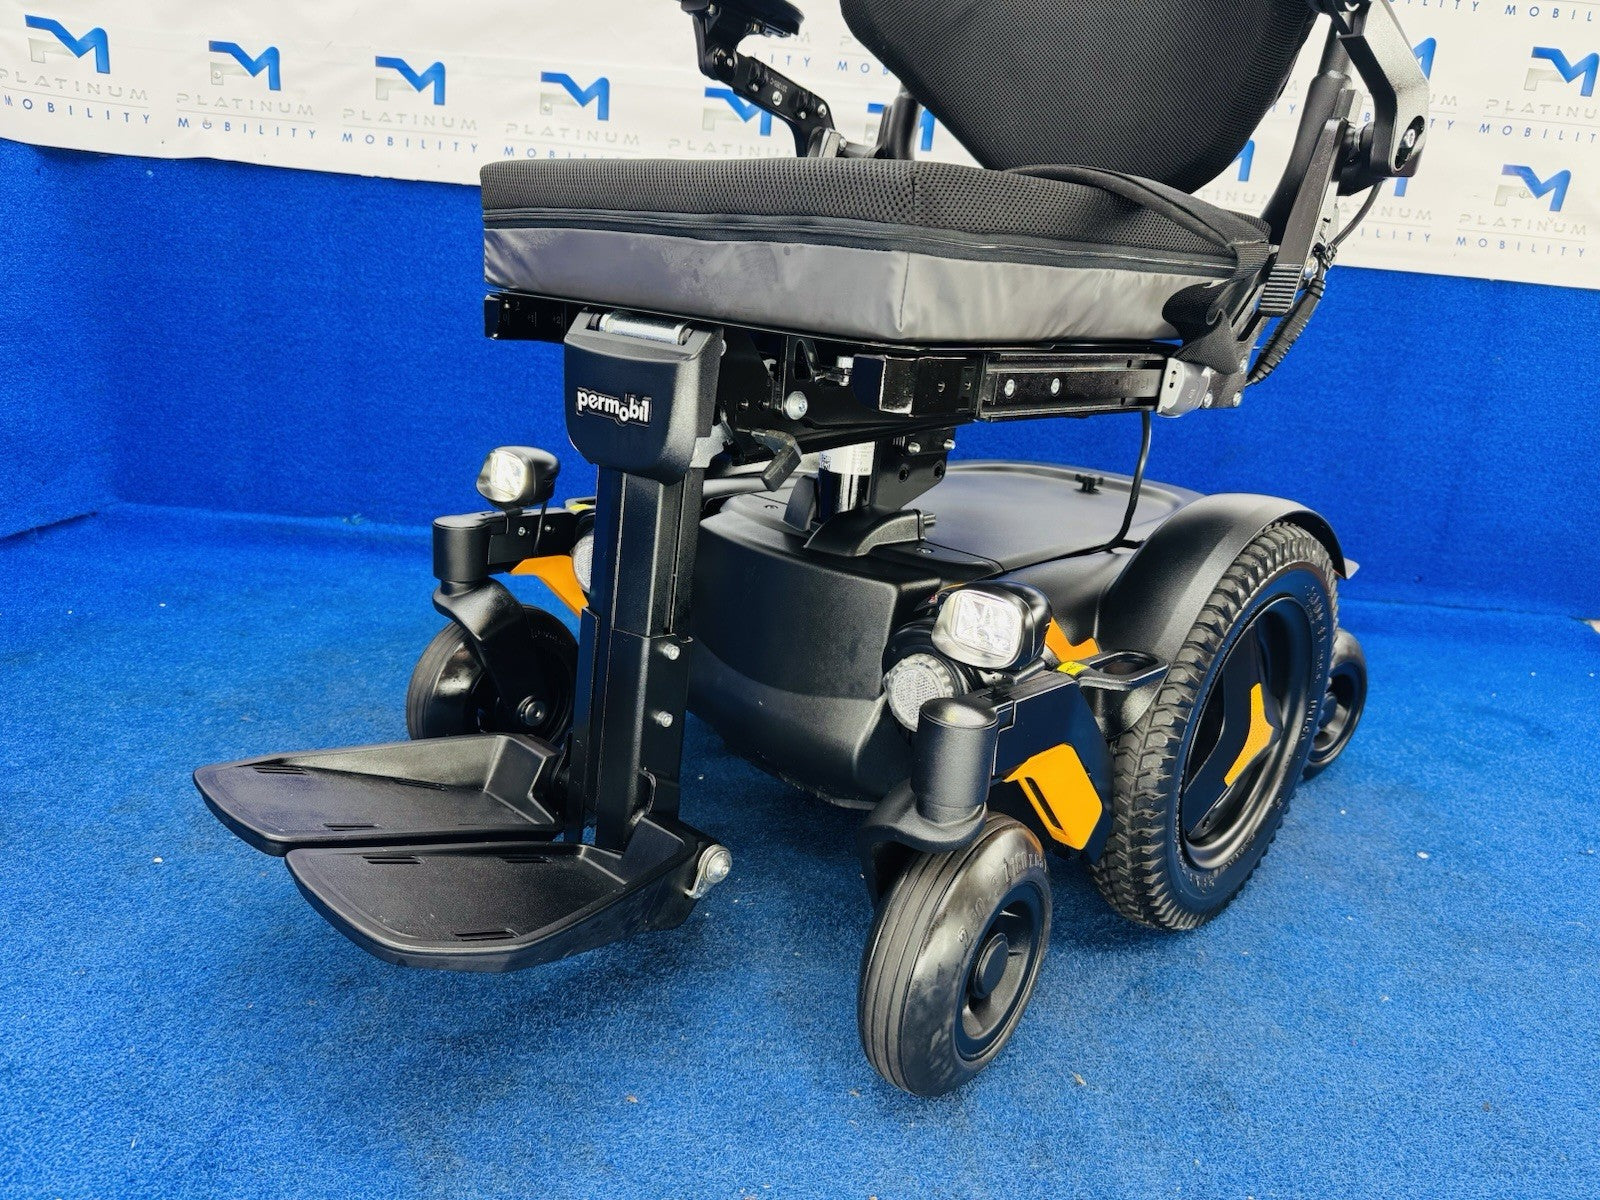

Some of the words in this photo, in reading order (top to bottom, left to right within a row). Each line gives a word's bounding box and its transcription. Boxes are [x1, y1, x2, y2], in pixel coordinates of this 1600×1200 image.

[0, 68, 149, 101] PLATINUM
[4, 94, 150, 124] MOBILITY
[176, 93, 314, 116] PLATINUM
[178, 117, 316, 139] MOBILITY
[343, 108, 477, 131] PLATINUM
[342, 132, 479, 153] MOBILITY
[505, 123, 640, 145] PLATINUM
[1459, 213, 1586, 236] PLATINUM
[1456, 237, 1585, 258] MOBILITY
[577, 390, 650, 423] permobil
